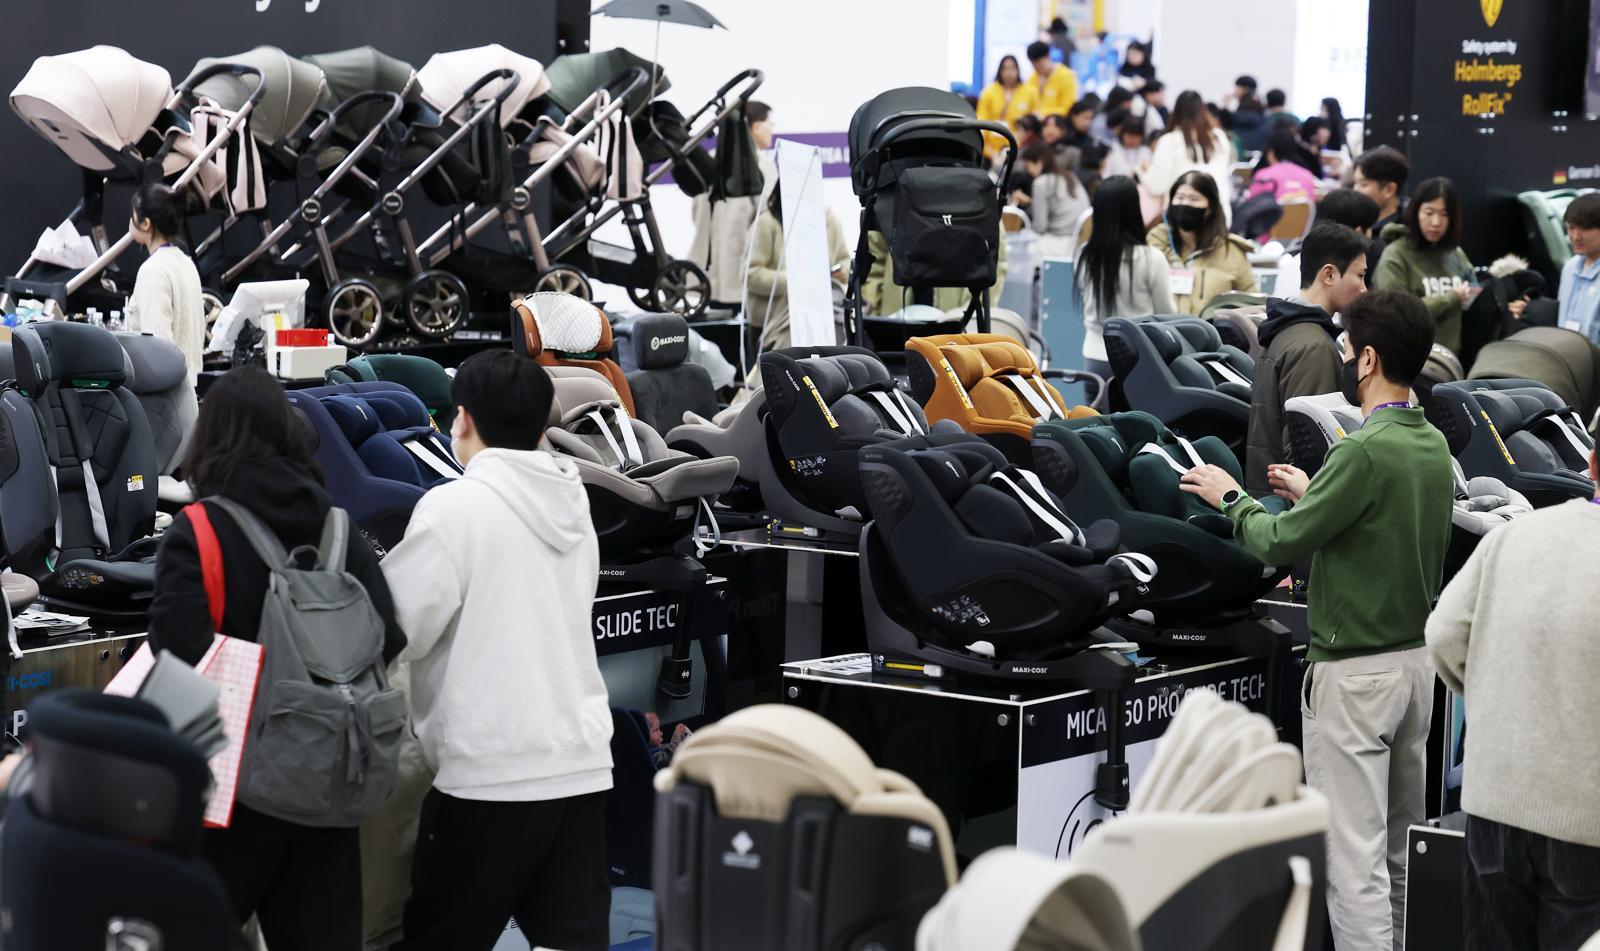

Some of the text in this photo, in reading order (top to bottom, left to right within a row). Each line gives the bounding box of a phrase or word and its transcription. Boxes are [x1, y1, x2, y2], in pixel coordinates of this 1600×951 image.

[1455, 58, 1521, 88] Holmbergs
[596, 603, 679, 640] SLIDE TEC
[8, 671, 53, 692] I-COSI
[1012, 666, 1048, 674] MAXI-COSI
[13, 709, 29, 737] P
[1066, 706, 1107, 739] MICA
[1147, 691, 1180, 722] PRO
